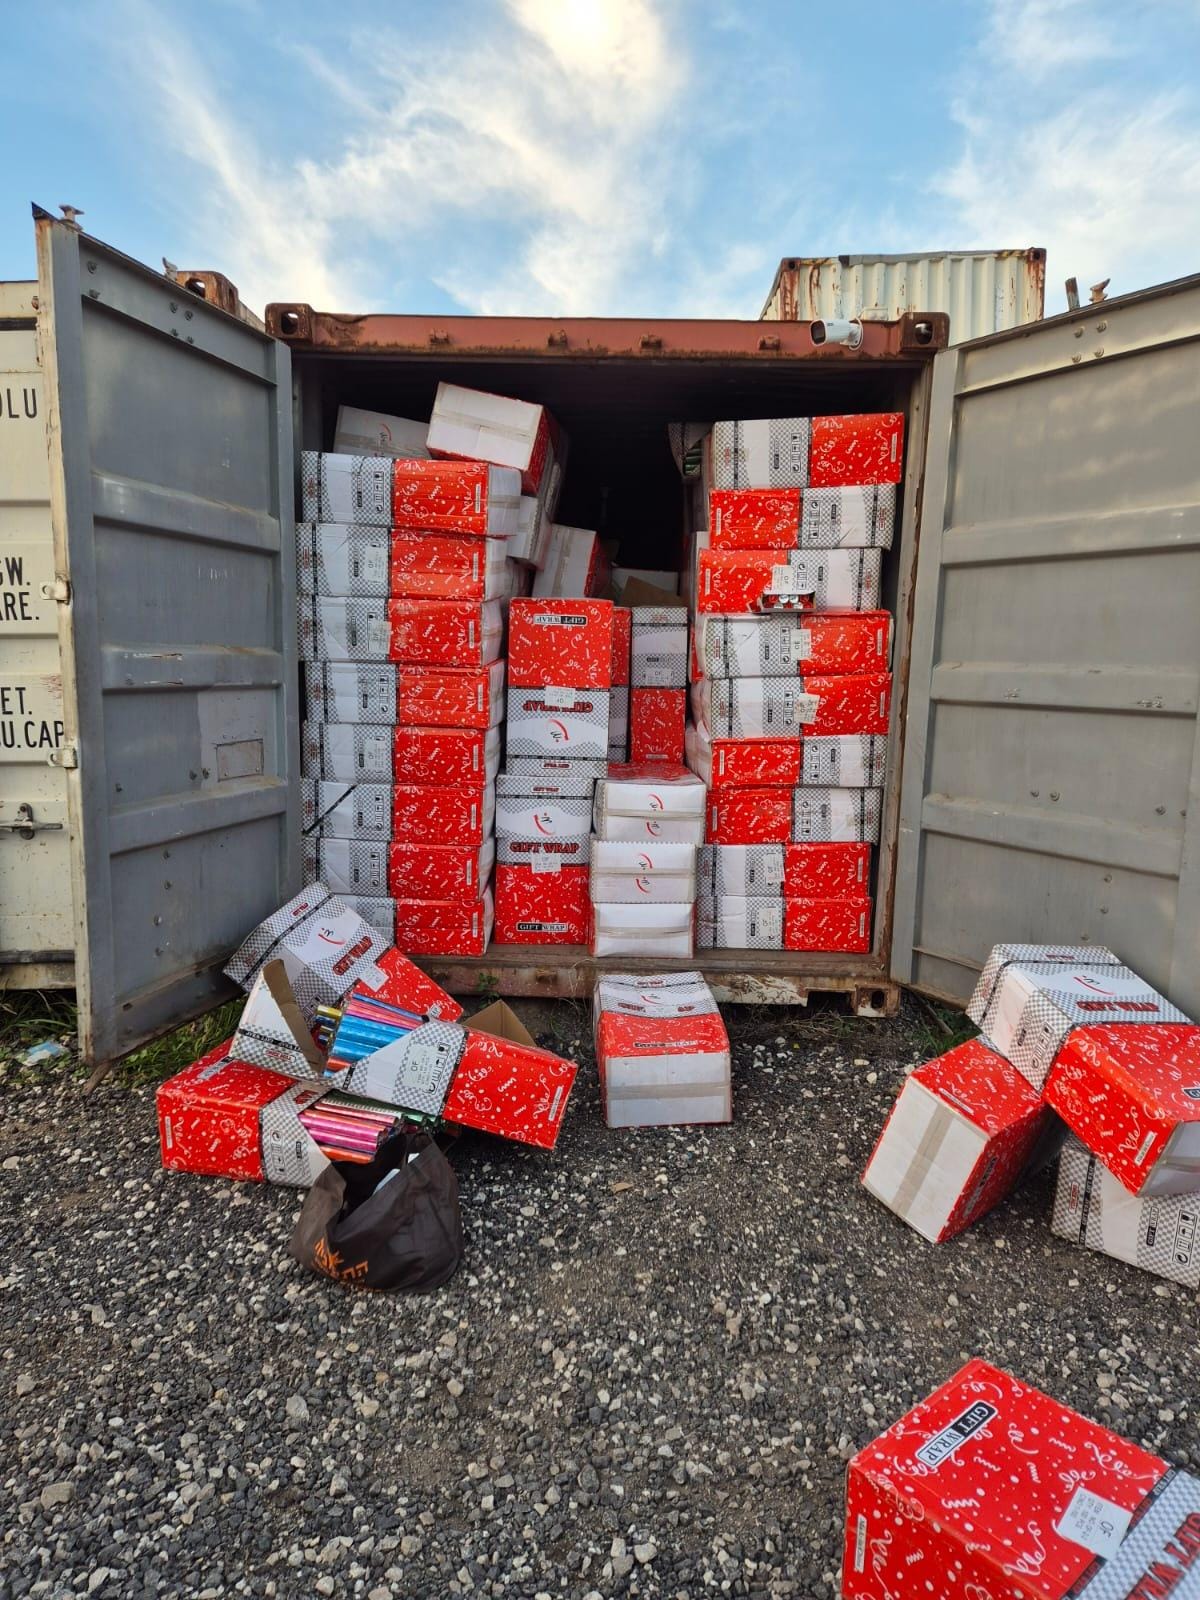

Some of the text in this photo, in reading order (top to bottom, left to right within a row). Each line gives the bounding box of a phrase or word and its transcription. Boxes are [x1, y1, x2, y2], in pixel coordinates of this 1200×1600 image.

[510, 842, 580, 854] GIFT WRAP
[411, 1060, 419, 1072] OF
[926, 1406, 989, 1461] GIFT WRAP
[1099, 1520, 1115, 1539] OF
